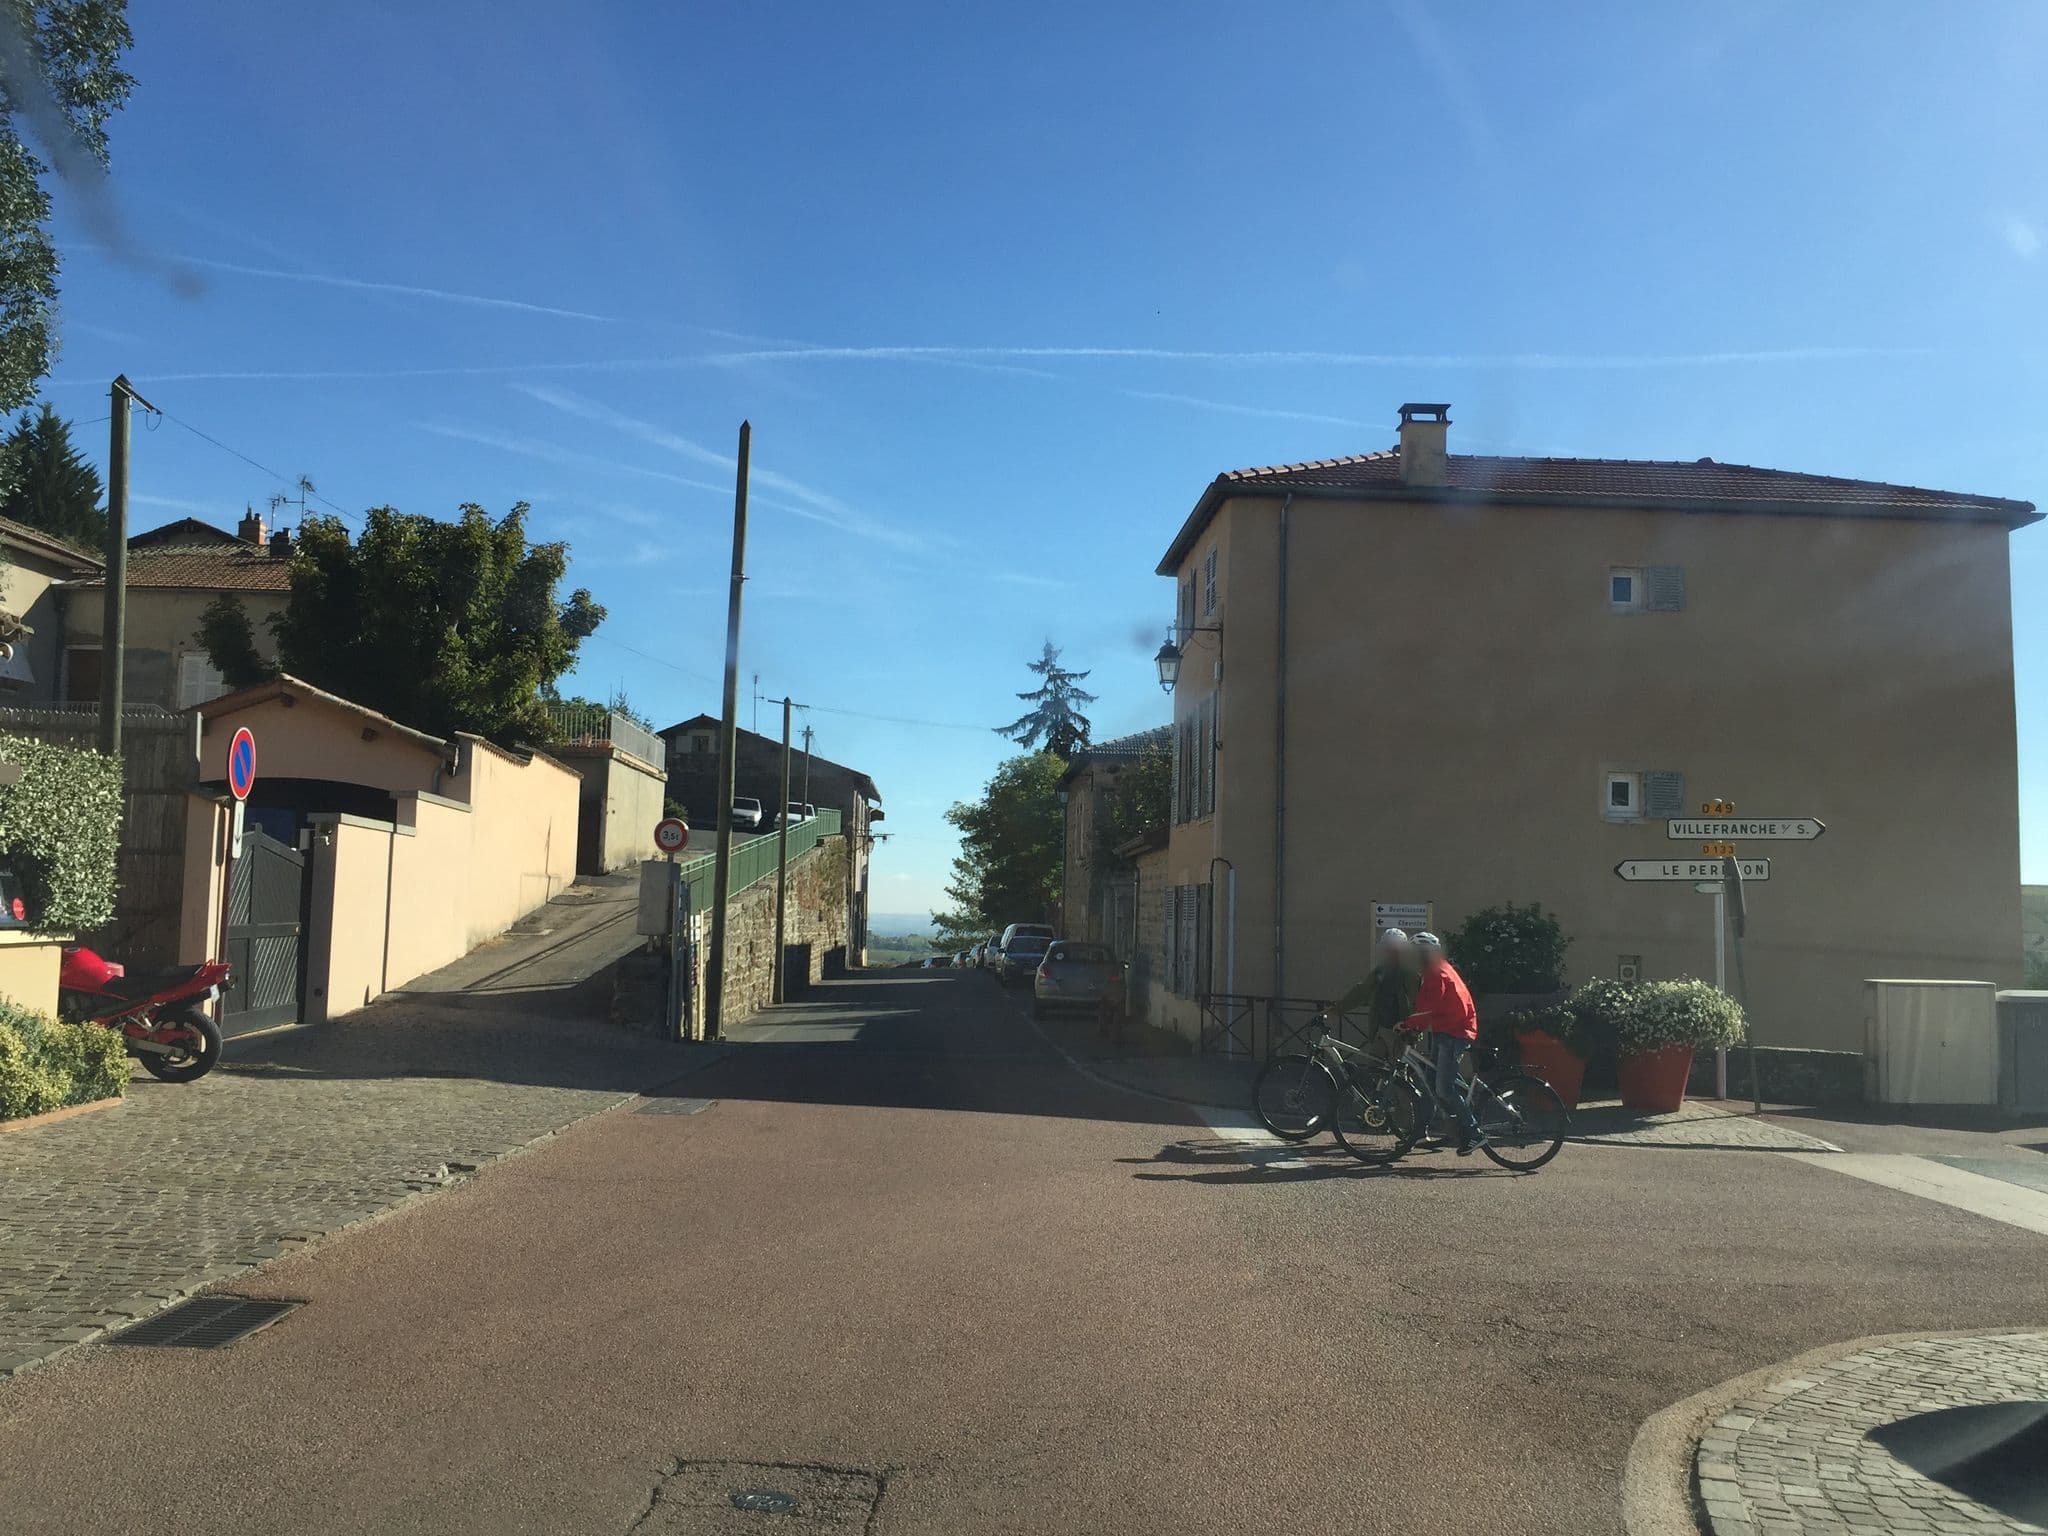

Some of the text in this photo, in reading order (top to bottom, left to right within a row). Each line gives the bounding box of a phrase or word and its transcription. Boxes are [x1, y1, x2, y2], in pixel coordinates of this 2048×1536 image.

[1702, 804, 1734, 814] D 49
[1673, 823, 1777, 835] VILLEFRANCHE
[1797, 824, 1810, 835] S.
[1702, 845, 1734, 855] D 133
[1630, 864, 1764, 876] 1 LE PERON
